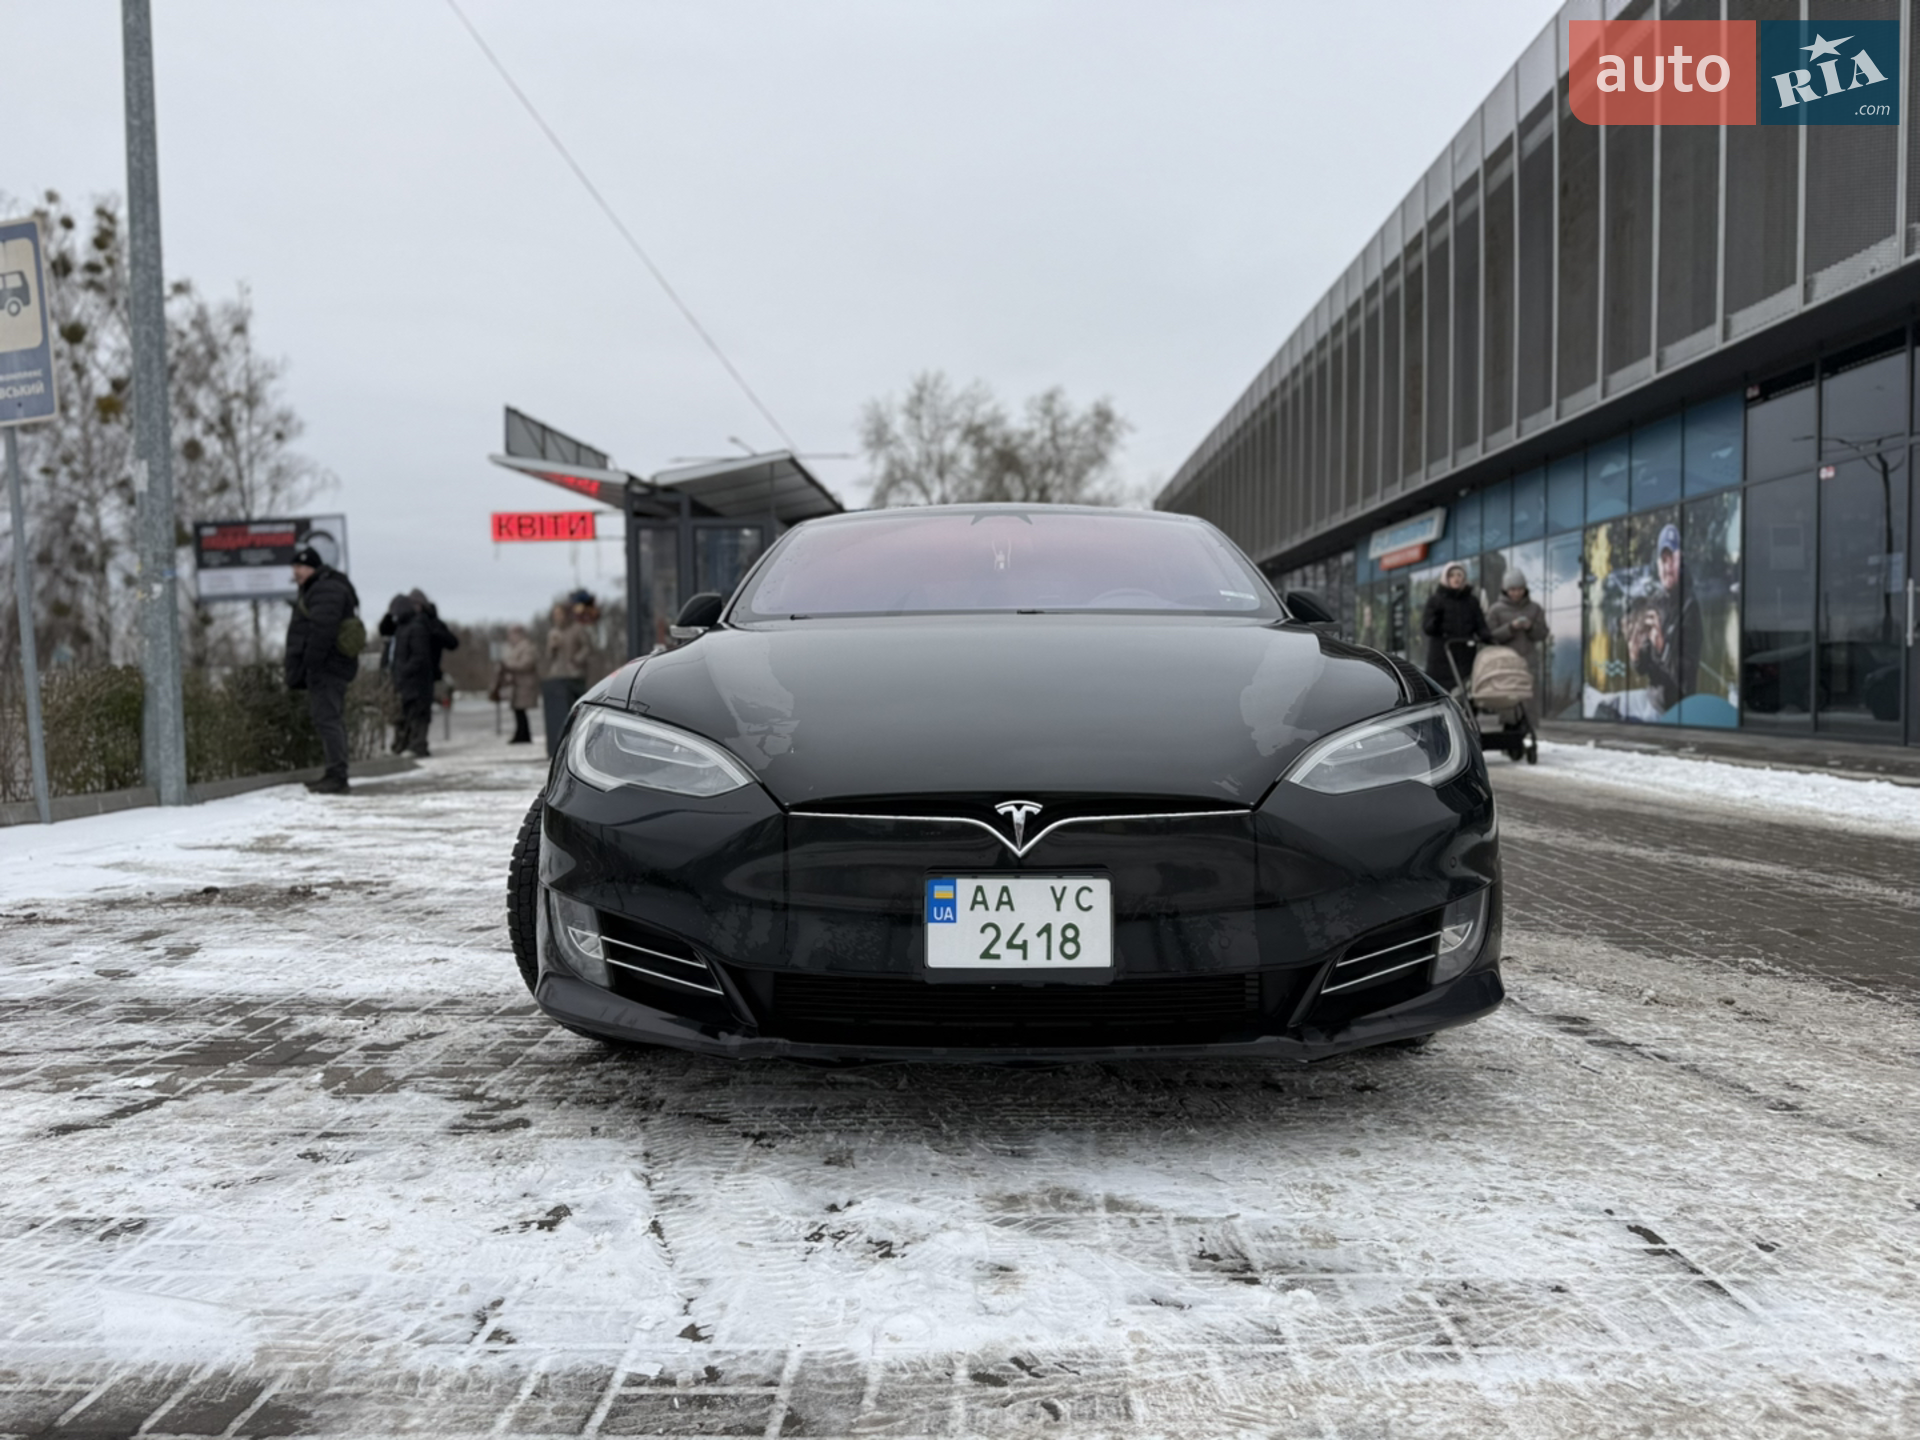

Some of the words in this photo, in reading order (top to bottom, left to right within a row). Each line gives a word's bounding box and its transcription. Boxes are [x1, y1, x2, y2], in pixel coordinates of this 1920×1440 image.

[498, 514, 587, 538] КВІТИ
[933, 906, 954, 921] UA
[979, 922, 1081, 961] 2418
